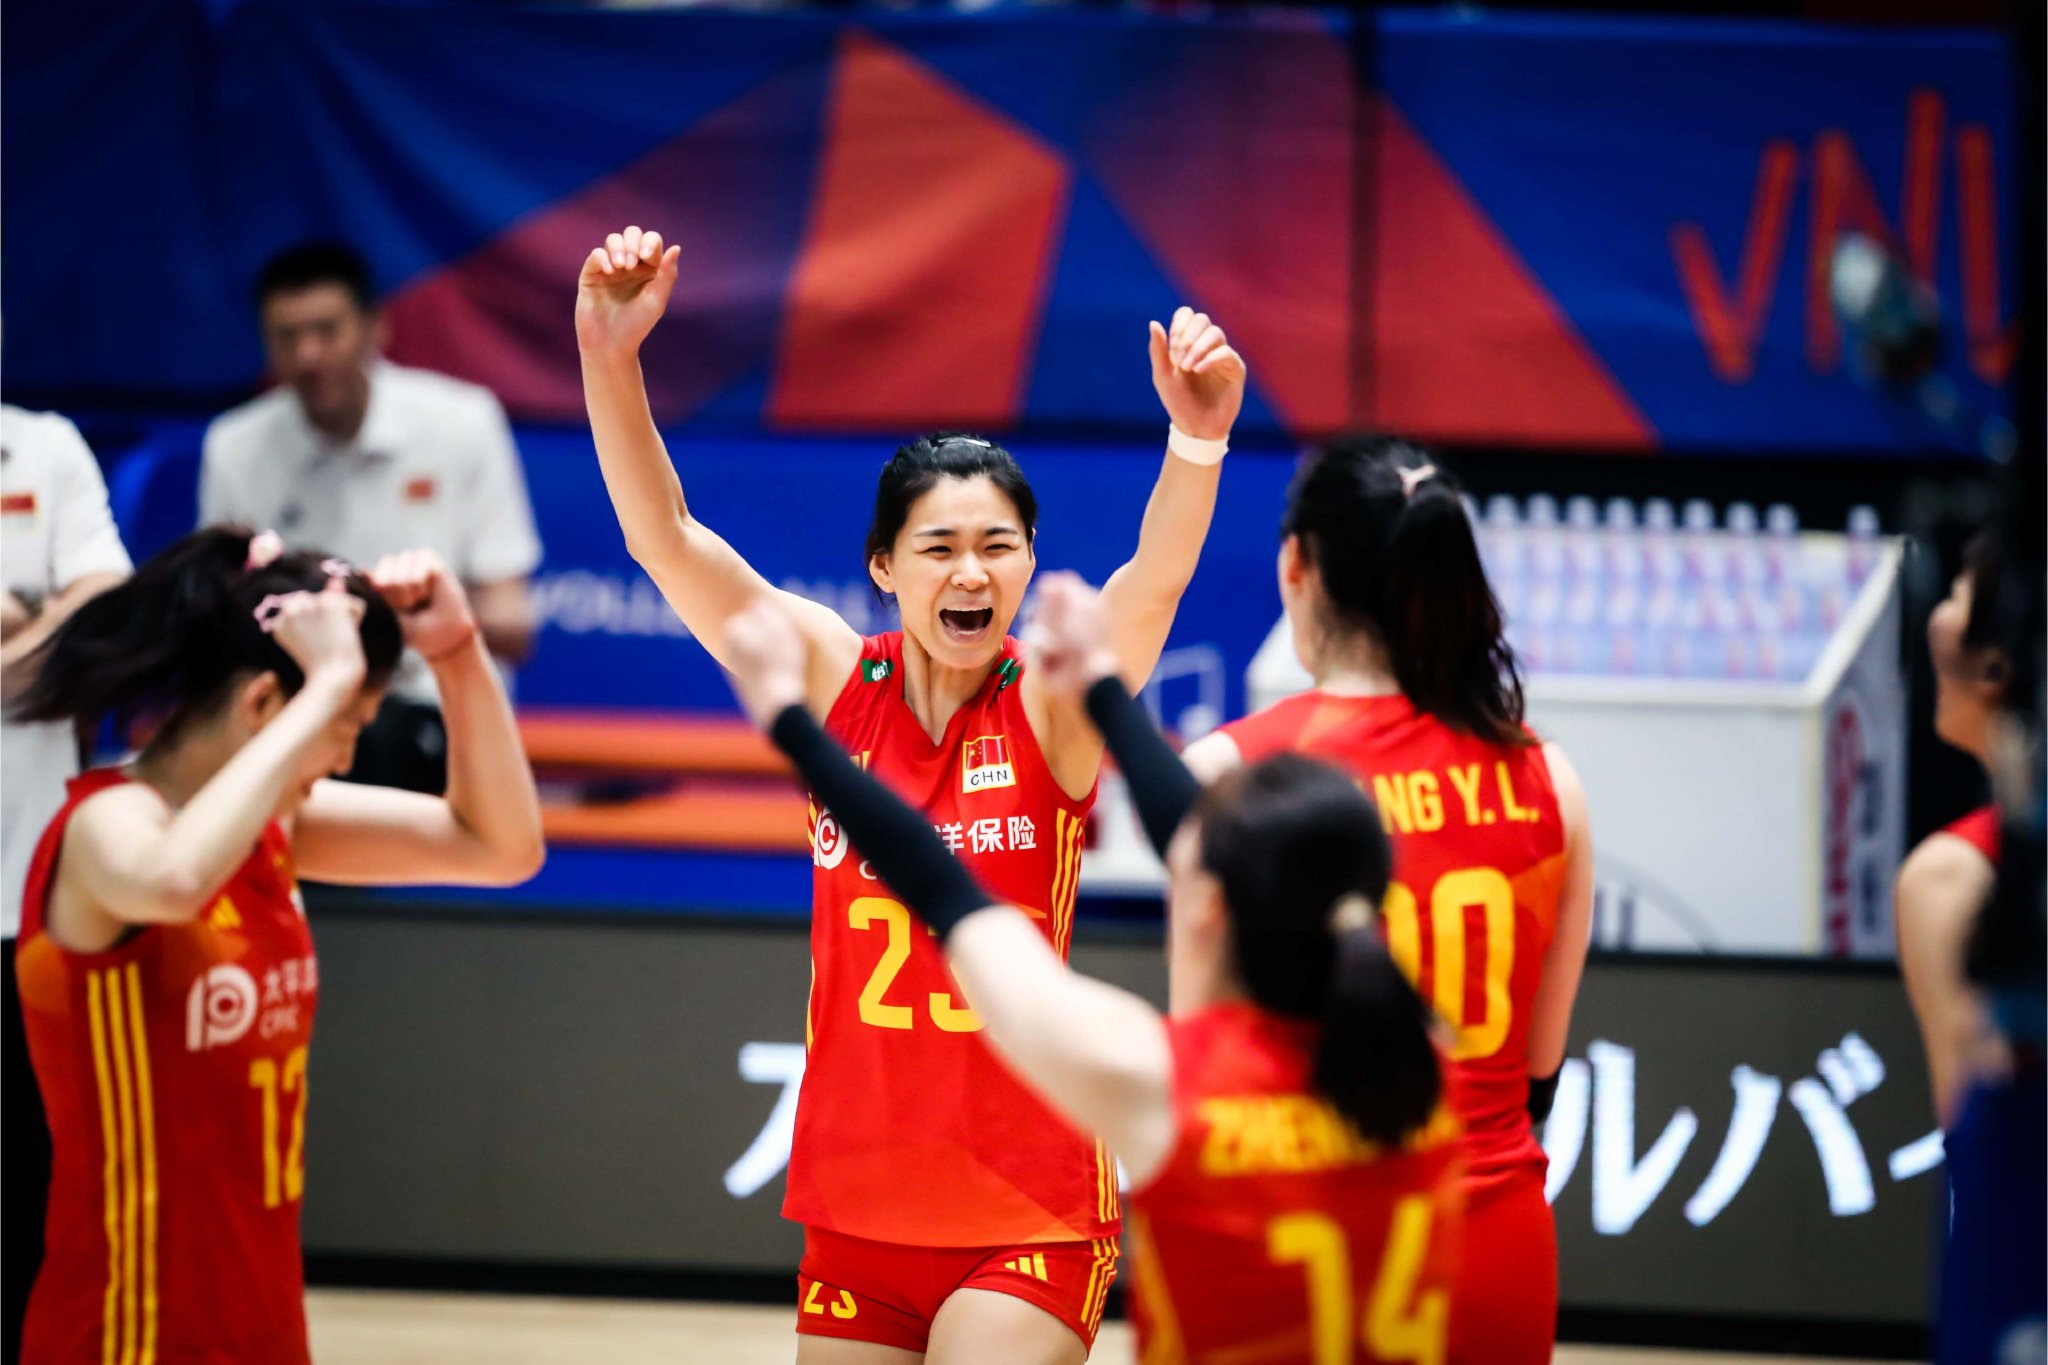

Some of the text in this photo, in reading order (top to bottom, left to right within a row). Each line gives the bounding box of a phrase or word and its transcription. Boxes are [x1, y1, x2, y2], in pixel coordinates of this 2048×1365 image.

[970, 769, 1008, 786] CHN
[1372, 769, 1446, 836] NG
[1541, 1031, 1946, 1237] ルバ
